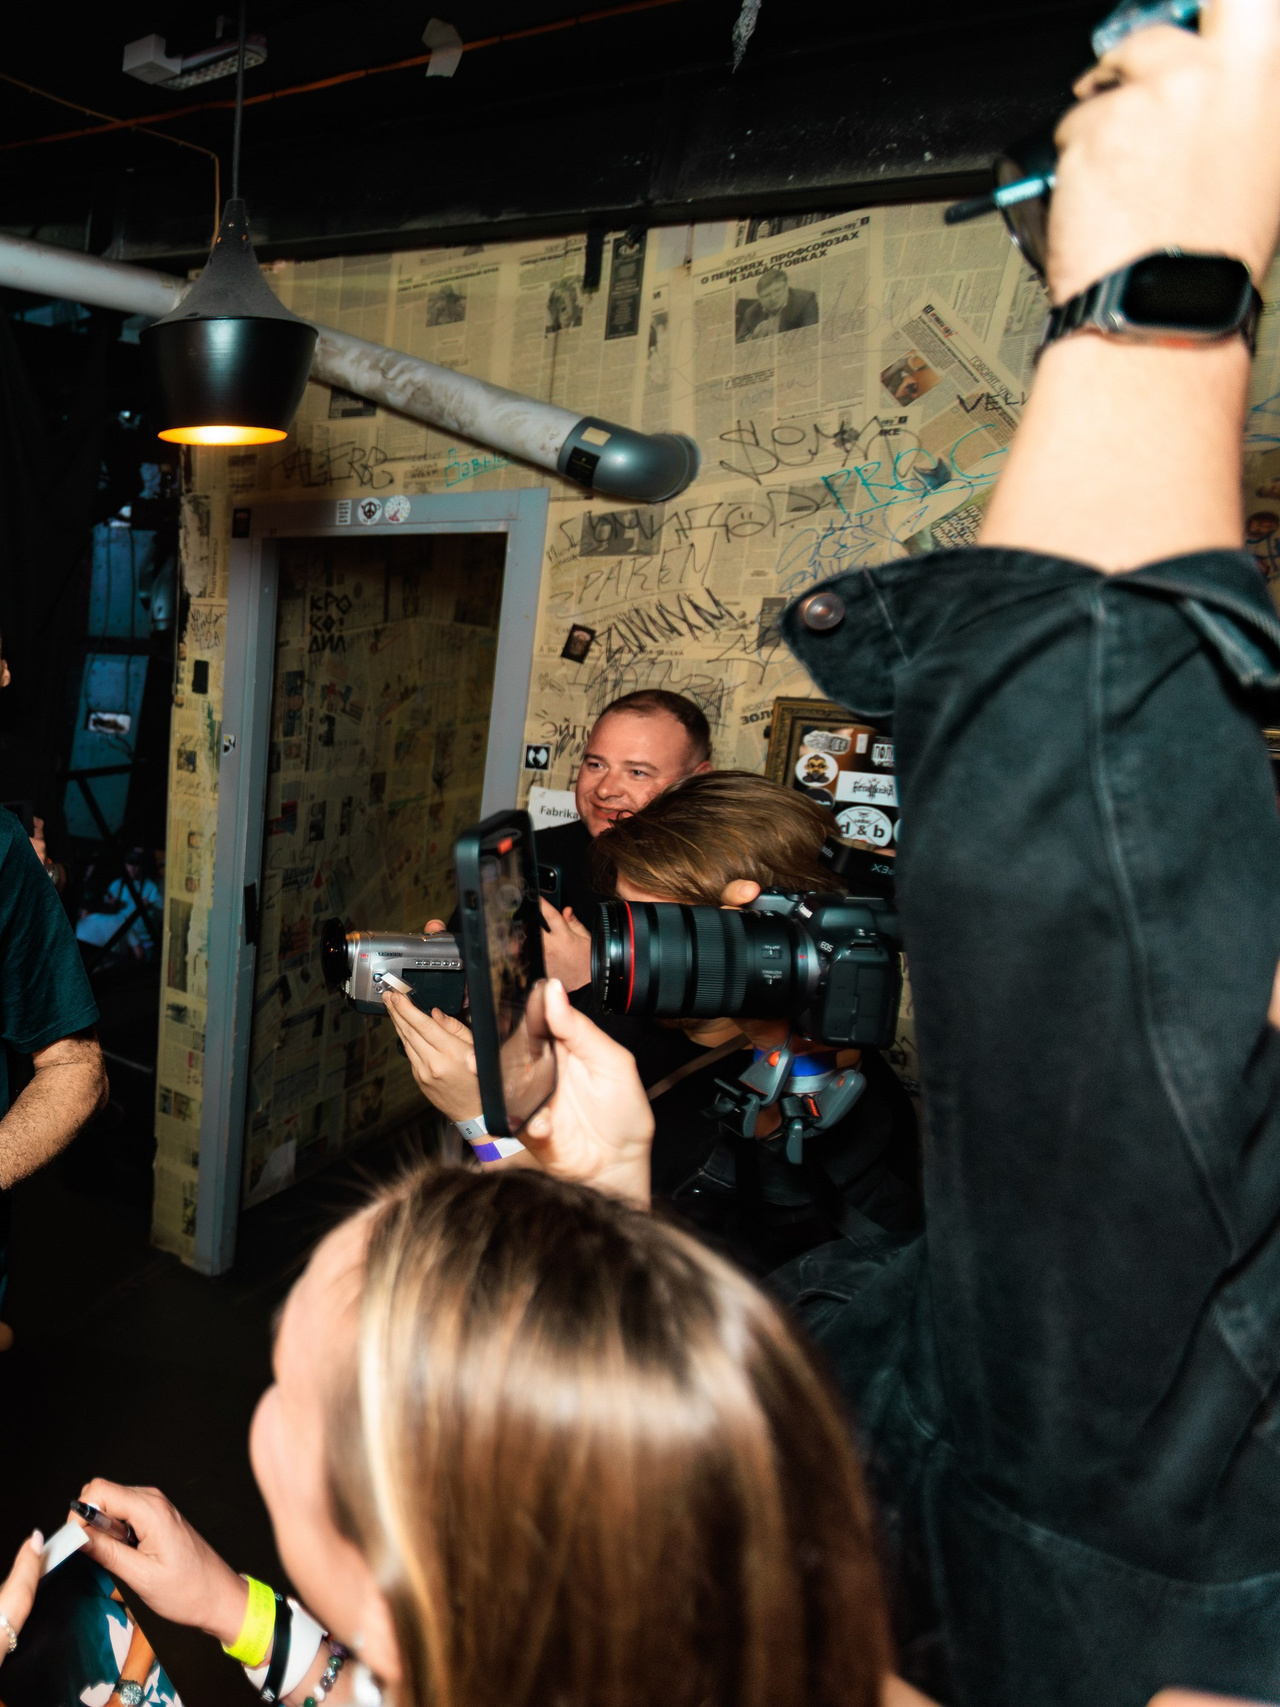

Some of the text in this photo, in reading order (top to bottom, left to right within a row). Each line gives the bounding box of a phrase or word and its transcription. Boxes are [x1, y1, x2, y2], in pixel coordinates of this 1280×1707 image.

[701, 276, 709, 285] О
[770, 231, 859, 264] ПРОФСОЮЗАХ
[540, 804, 580, 820] Fabrika
[872, 823, 886, 839] b
